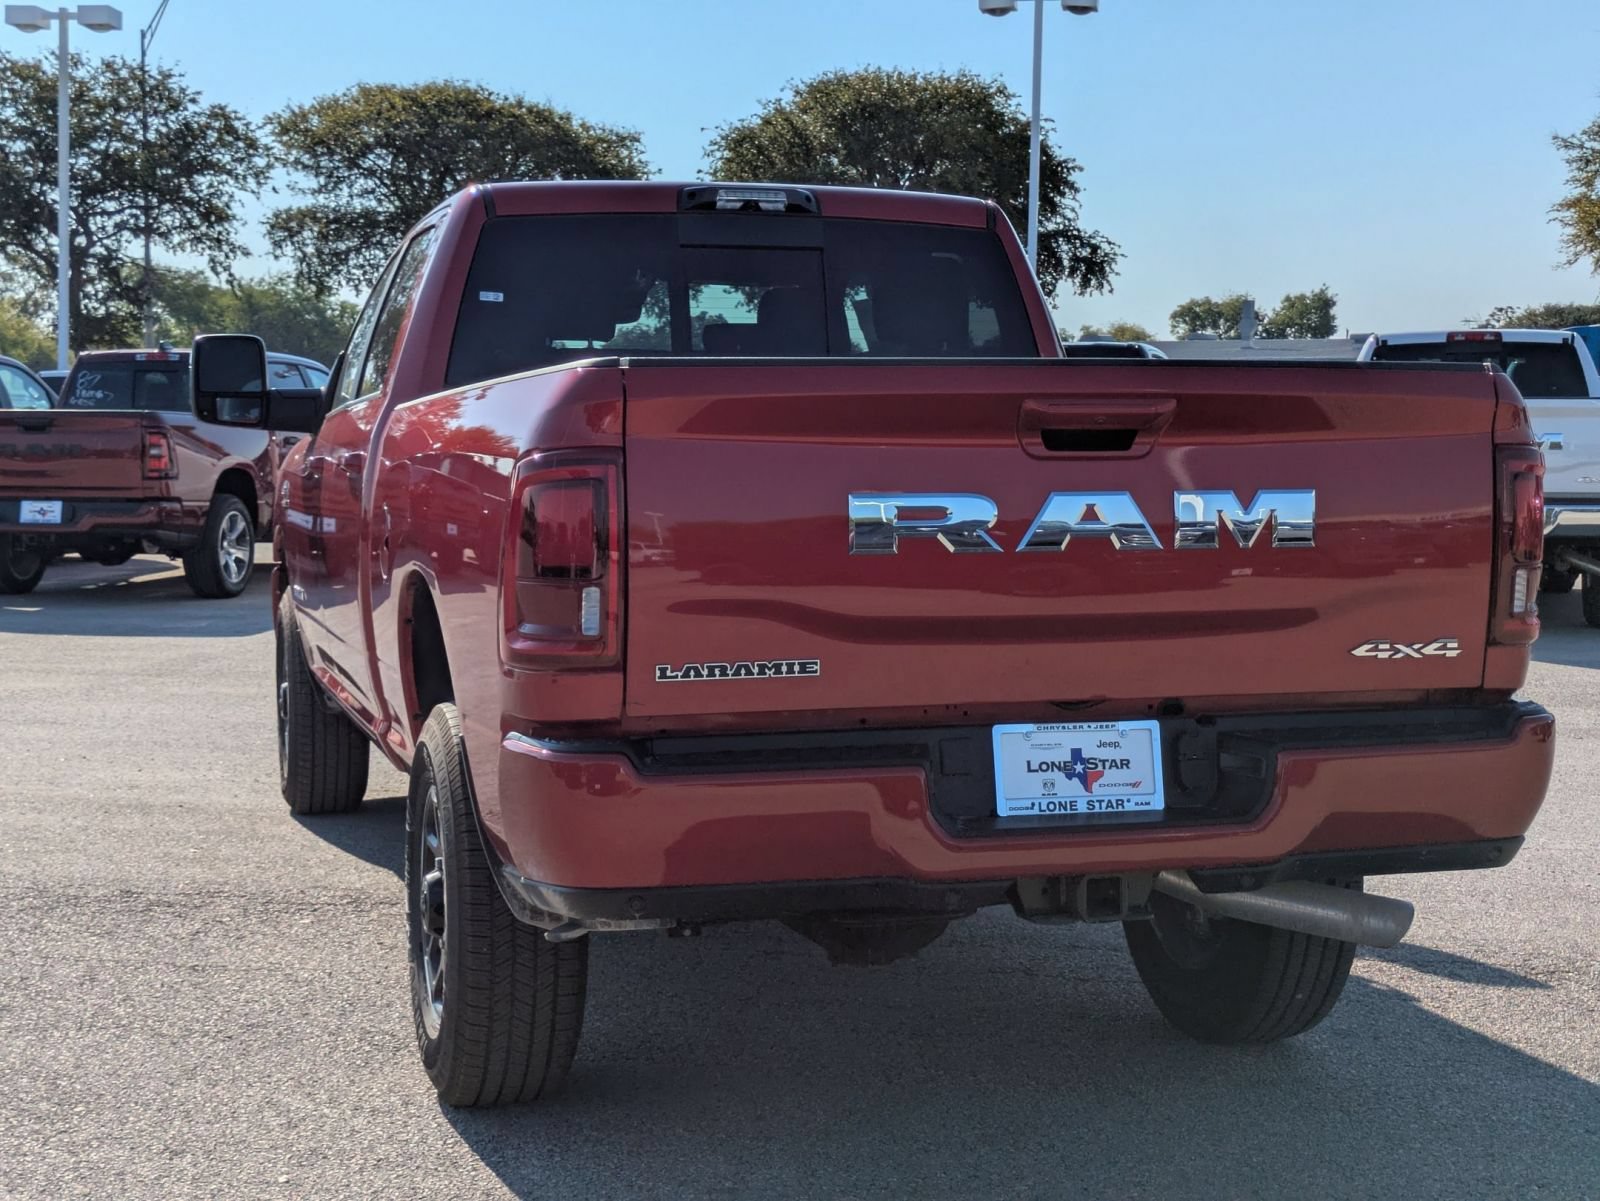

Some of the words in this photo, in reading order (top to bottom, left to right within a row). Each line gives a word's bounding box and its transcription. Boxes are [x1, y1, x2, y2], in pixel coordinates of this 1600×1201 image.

[848, 488, 1317, 555] RAM
[1350, 638, 1463, 659] 4x4
[655, 659, 820, 682] LARAMIE
[1096, 739, 1120, 749] Jeep
[1026, 760, 1073, 774] LONE
[1085, 757, 1131, 771] STAR
[1038, 800, 1079, 813] LONE
[1086, 798, 1125, 811] STAR
